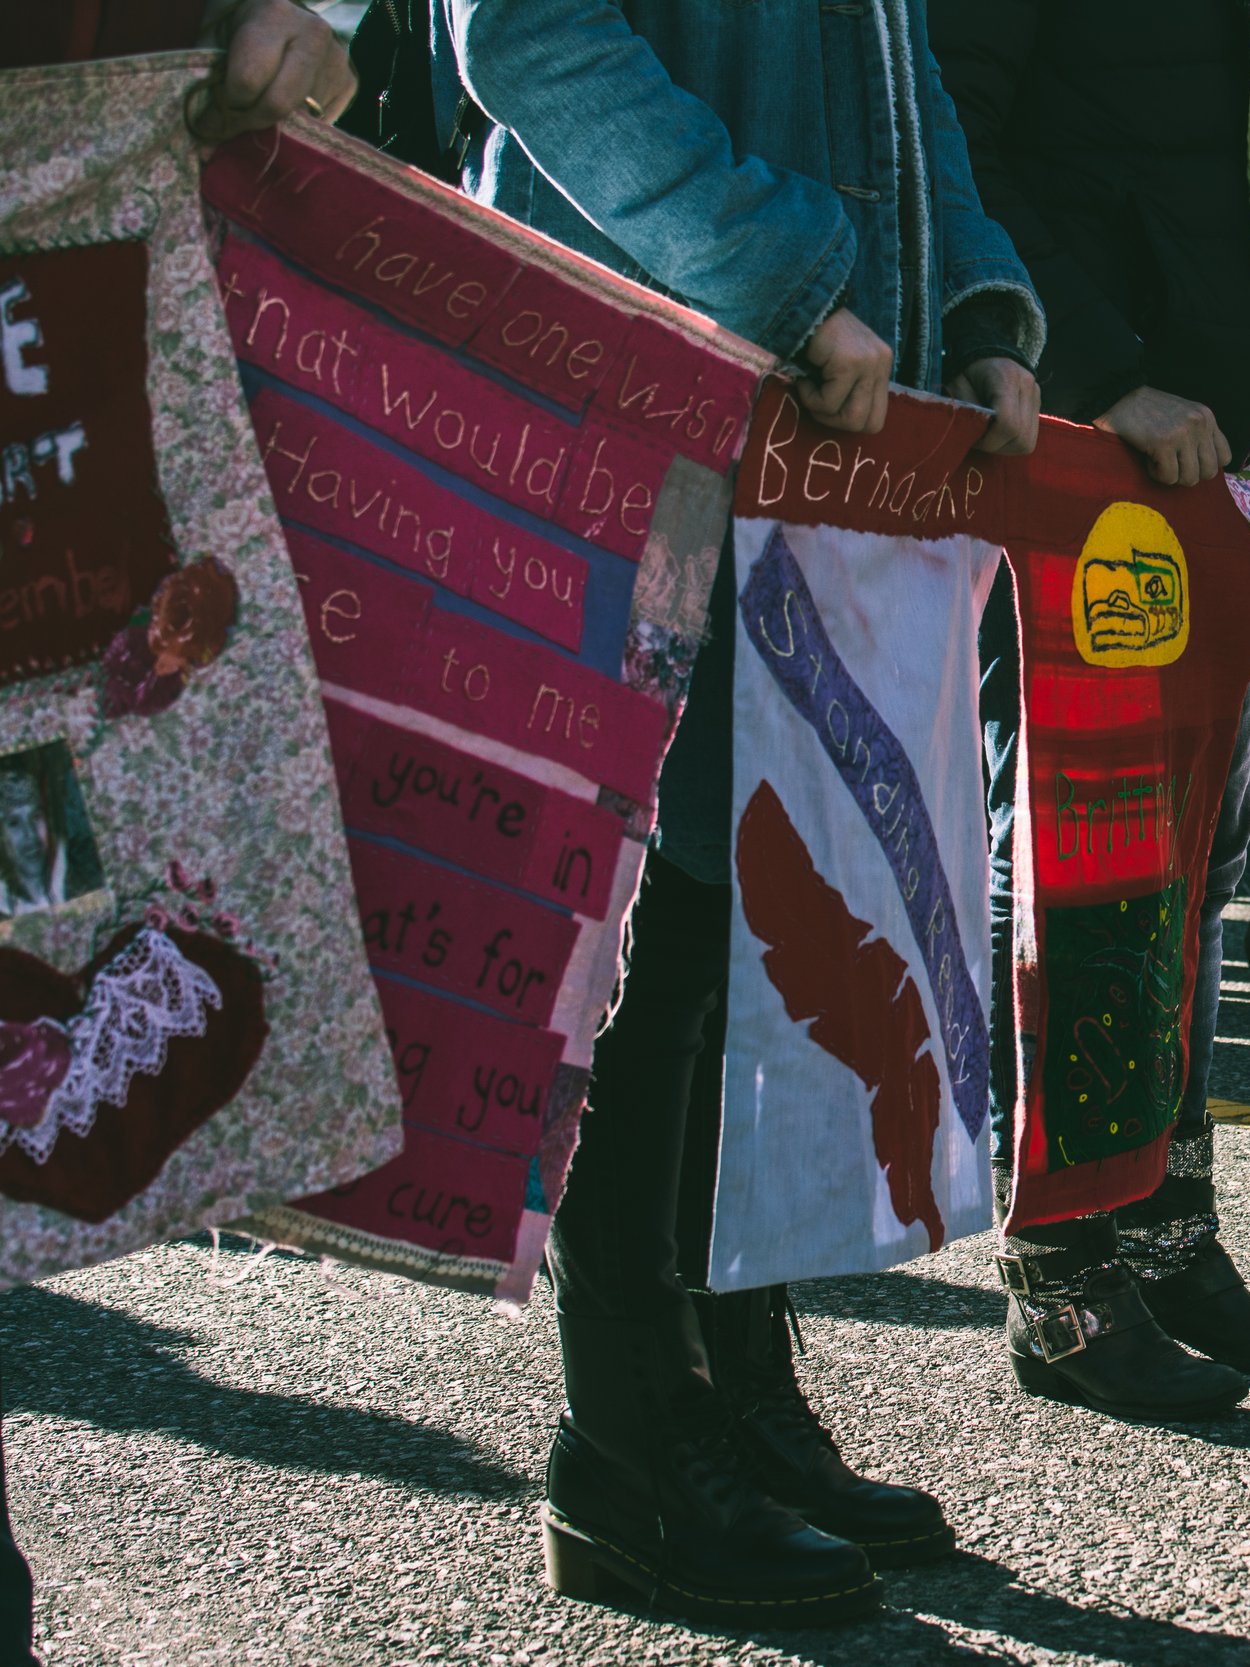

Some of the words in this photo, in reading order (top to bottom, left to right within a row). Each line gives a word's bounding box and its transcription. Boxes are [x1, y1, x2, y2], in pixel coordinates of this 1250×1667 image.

[334, 216, 488, 319] have
[501, 310, 604, 379] one
[0, 421, 88, 503] RT
[380, 364, 566, 502] would
[579, 437, 651, 536] be
[262, 422, 455, 579] Having
[488, 537, 574, 608] you
[440, 648, 490, 702] to
[527, 683, 602, 749] me
[372, 755, 526, 839] you're
[553, 831, 593, 896] in
[476, 931, 546, 1002] for
[455, 1062, 540, 1132] you
[386, 1183, 497, 1238] cure
